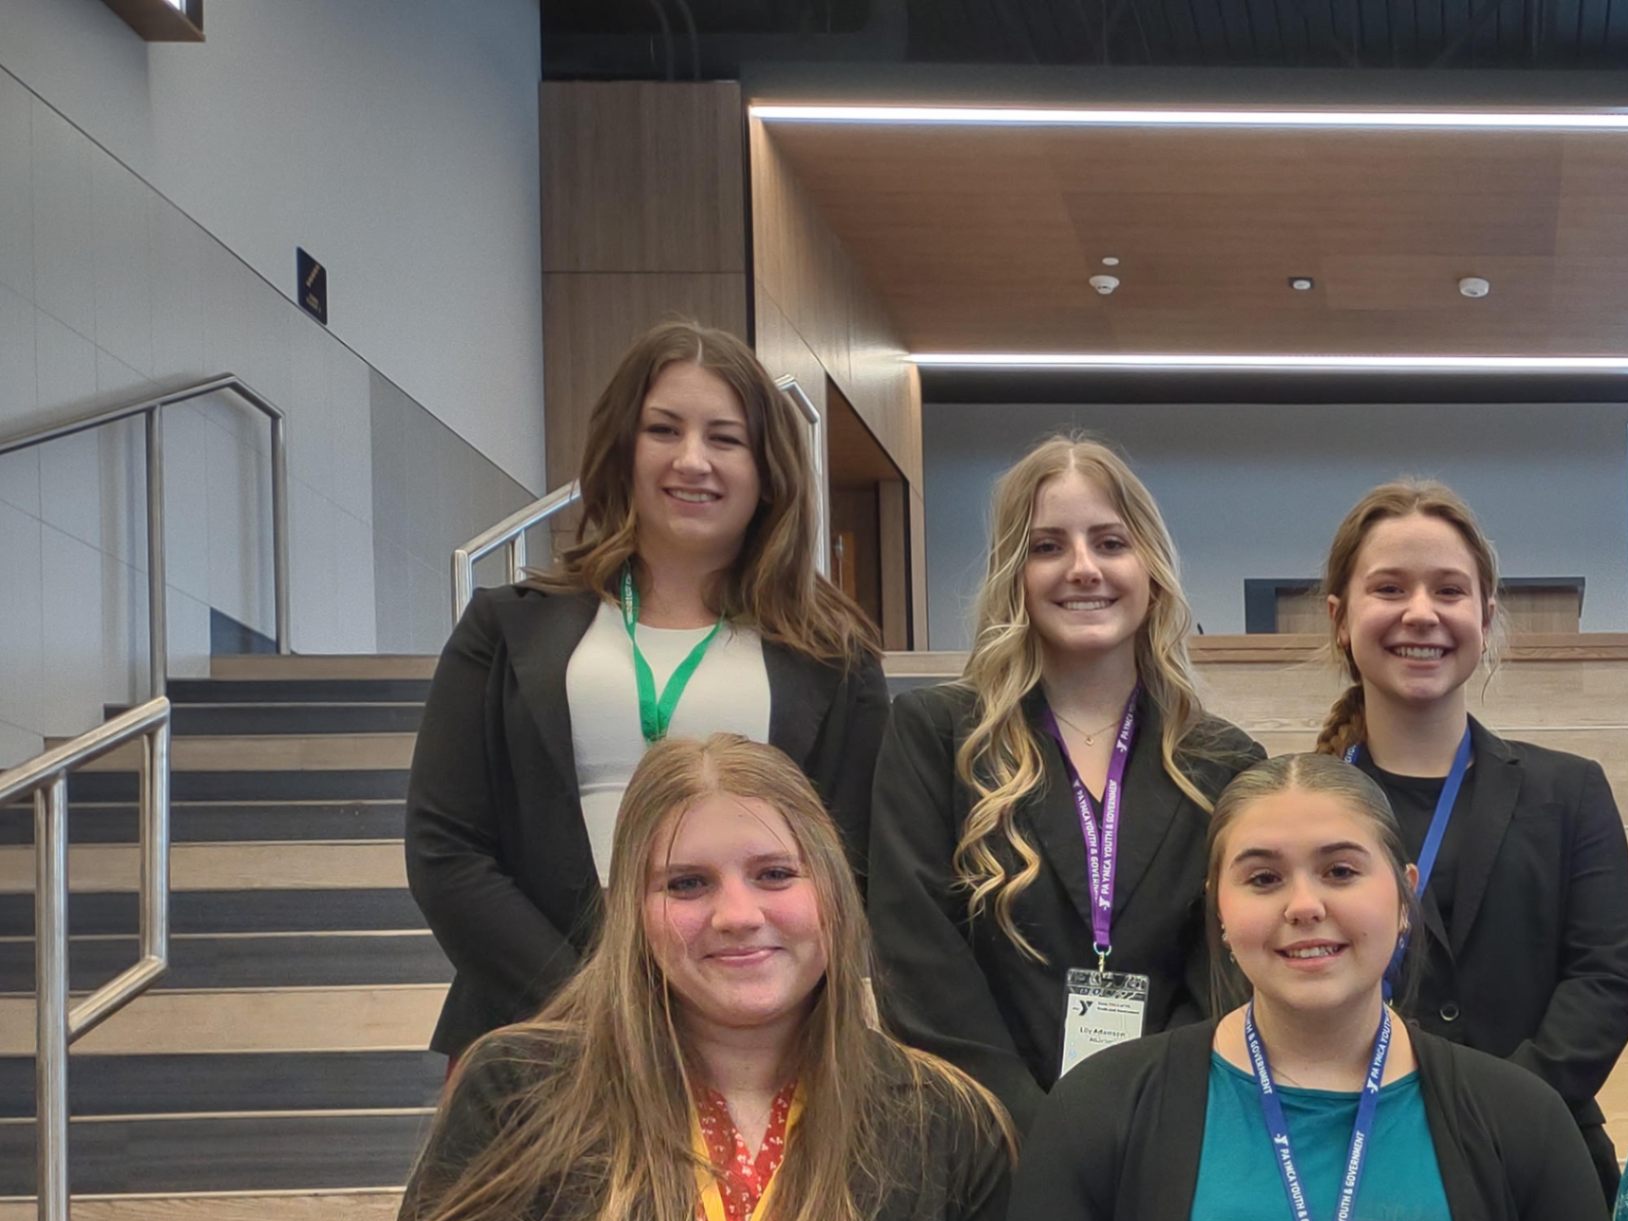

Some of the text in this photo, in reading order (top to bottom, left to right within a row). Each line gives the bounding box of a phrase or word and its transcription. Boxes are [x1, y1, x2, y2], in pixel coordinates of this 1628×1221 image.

[1085, 821, 1097, 848] YOUTH
[1104, 830, 1112, 858] YOUTH
[1250, 1040, 1273, 1094] GOVERNMENT
[1374, 1044, 1387, 1067] YMCA
[1370, 1066, 1380, 1079] PA
[1280, 1148, 1290, 1160] PA
[1345, 1130, 1365, 1187] GOVERNMENT
[1283, 1160, 1296, 1182] YMCA
[1289, 1181, 1305, 1212] YOUTH
